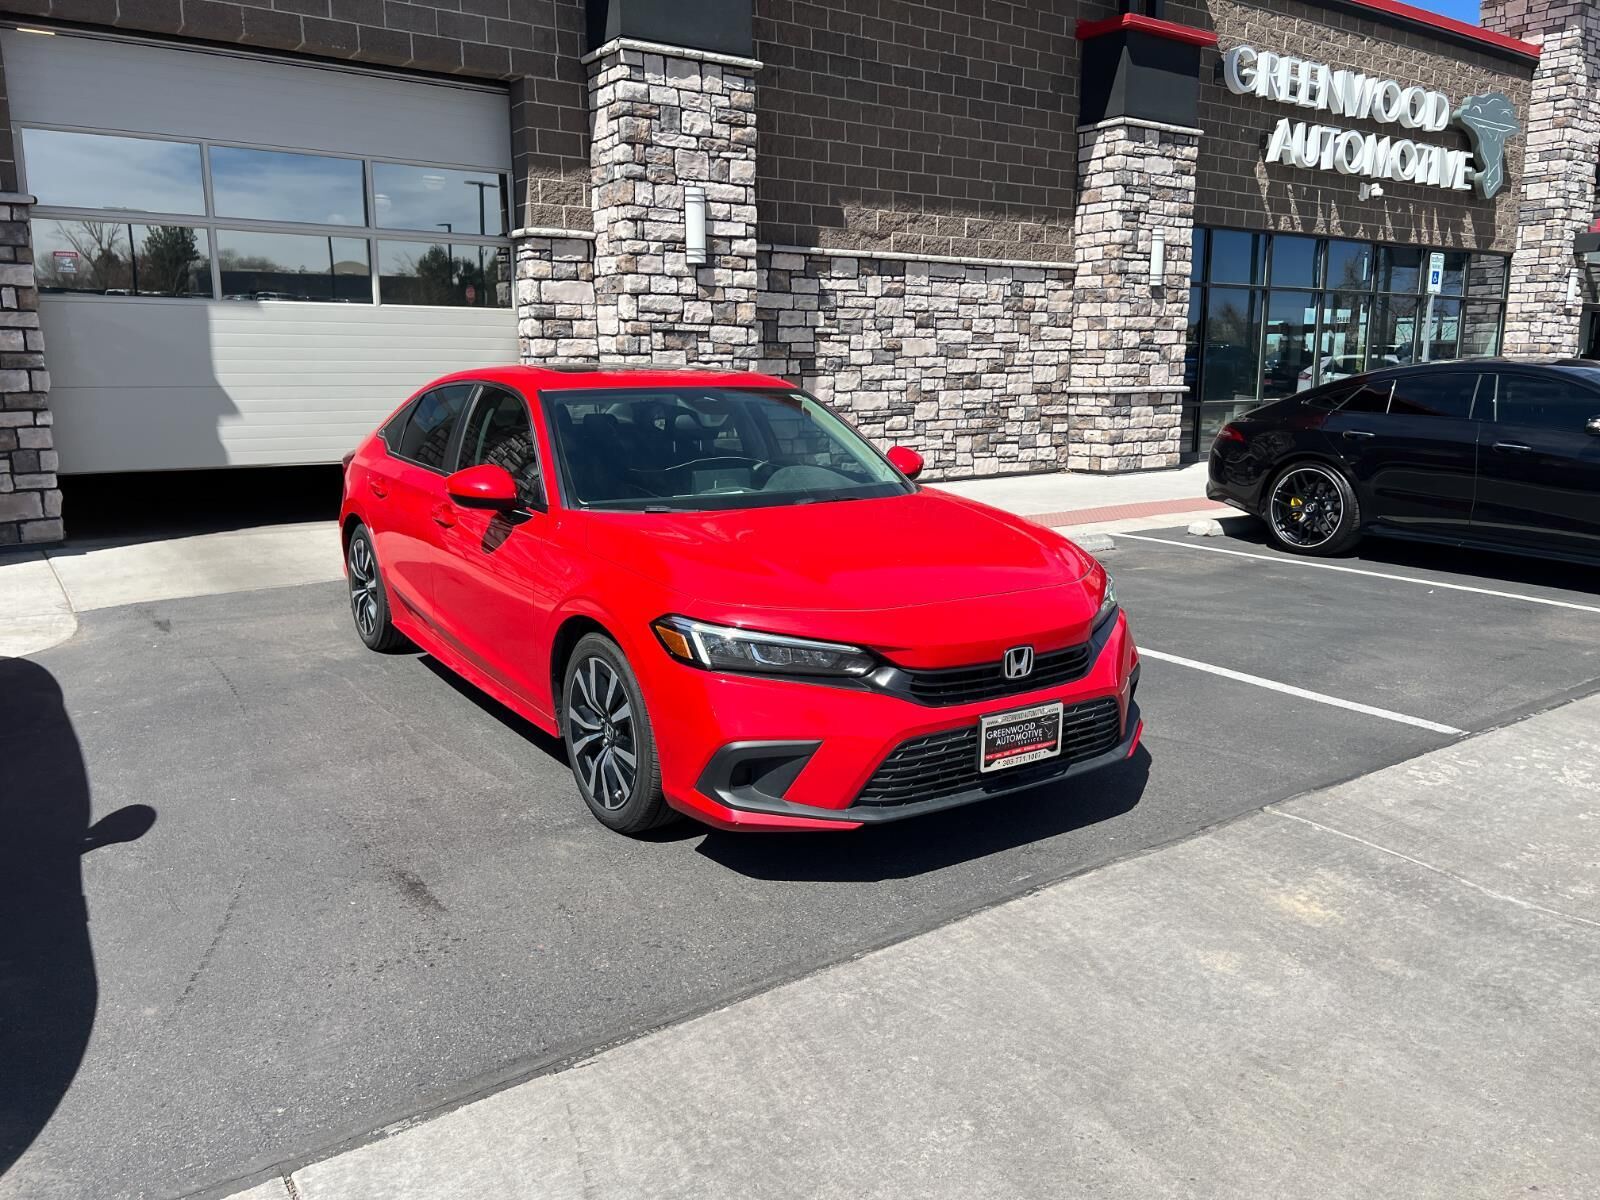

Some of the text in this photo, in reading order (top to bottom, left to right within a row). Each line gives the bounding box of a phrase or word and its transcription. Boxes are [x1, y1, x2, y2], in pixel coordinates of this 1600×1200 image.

[1224, 45, 1450, 132] GREENWOOD
[1265, 118, 1473, 190] AUTOMOTIVE
[986, 722, 1036, 740] GREENWOOD
[995, 728, 1043, 746] AUTOMOTIVE
[1017, 737, 1043, 745] SERVICES
